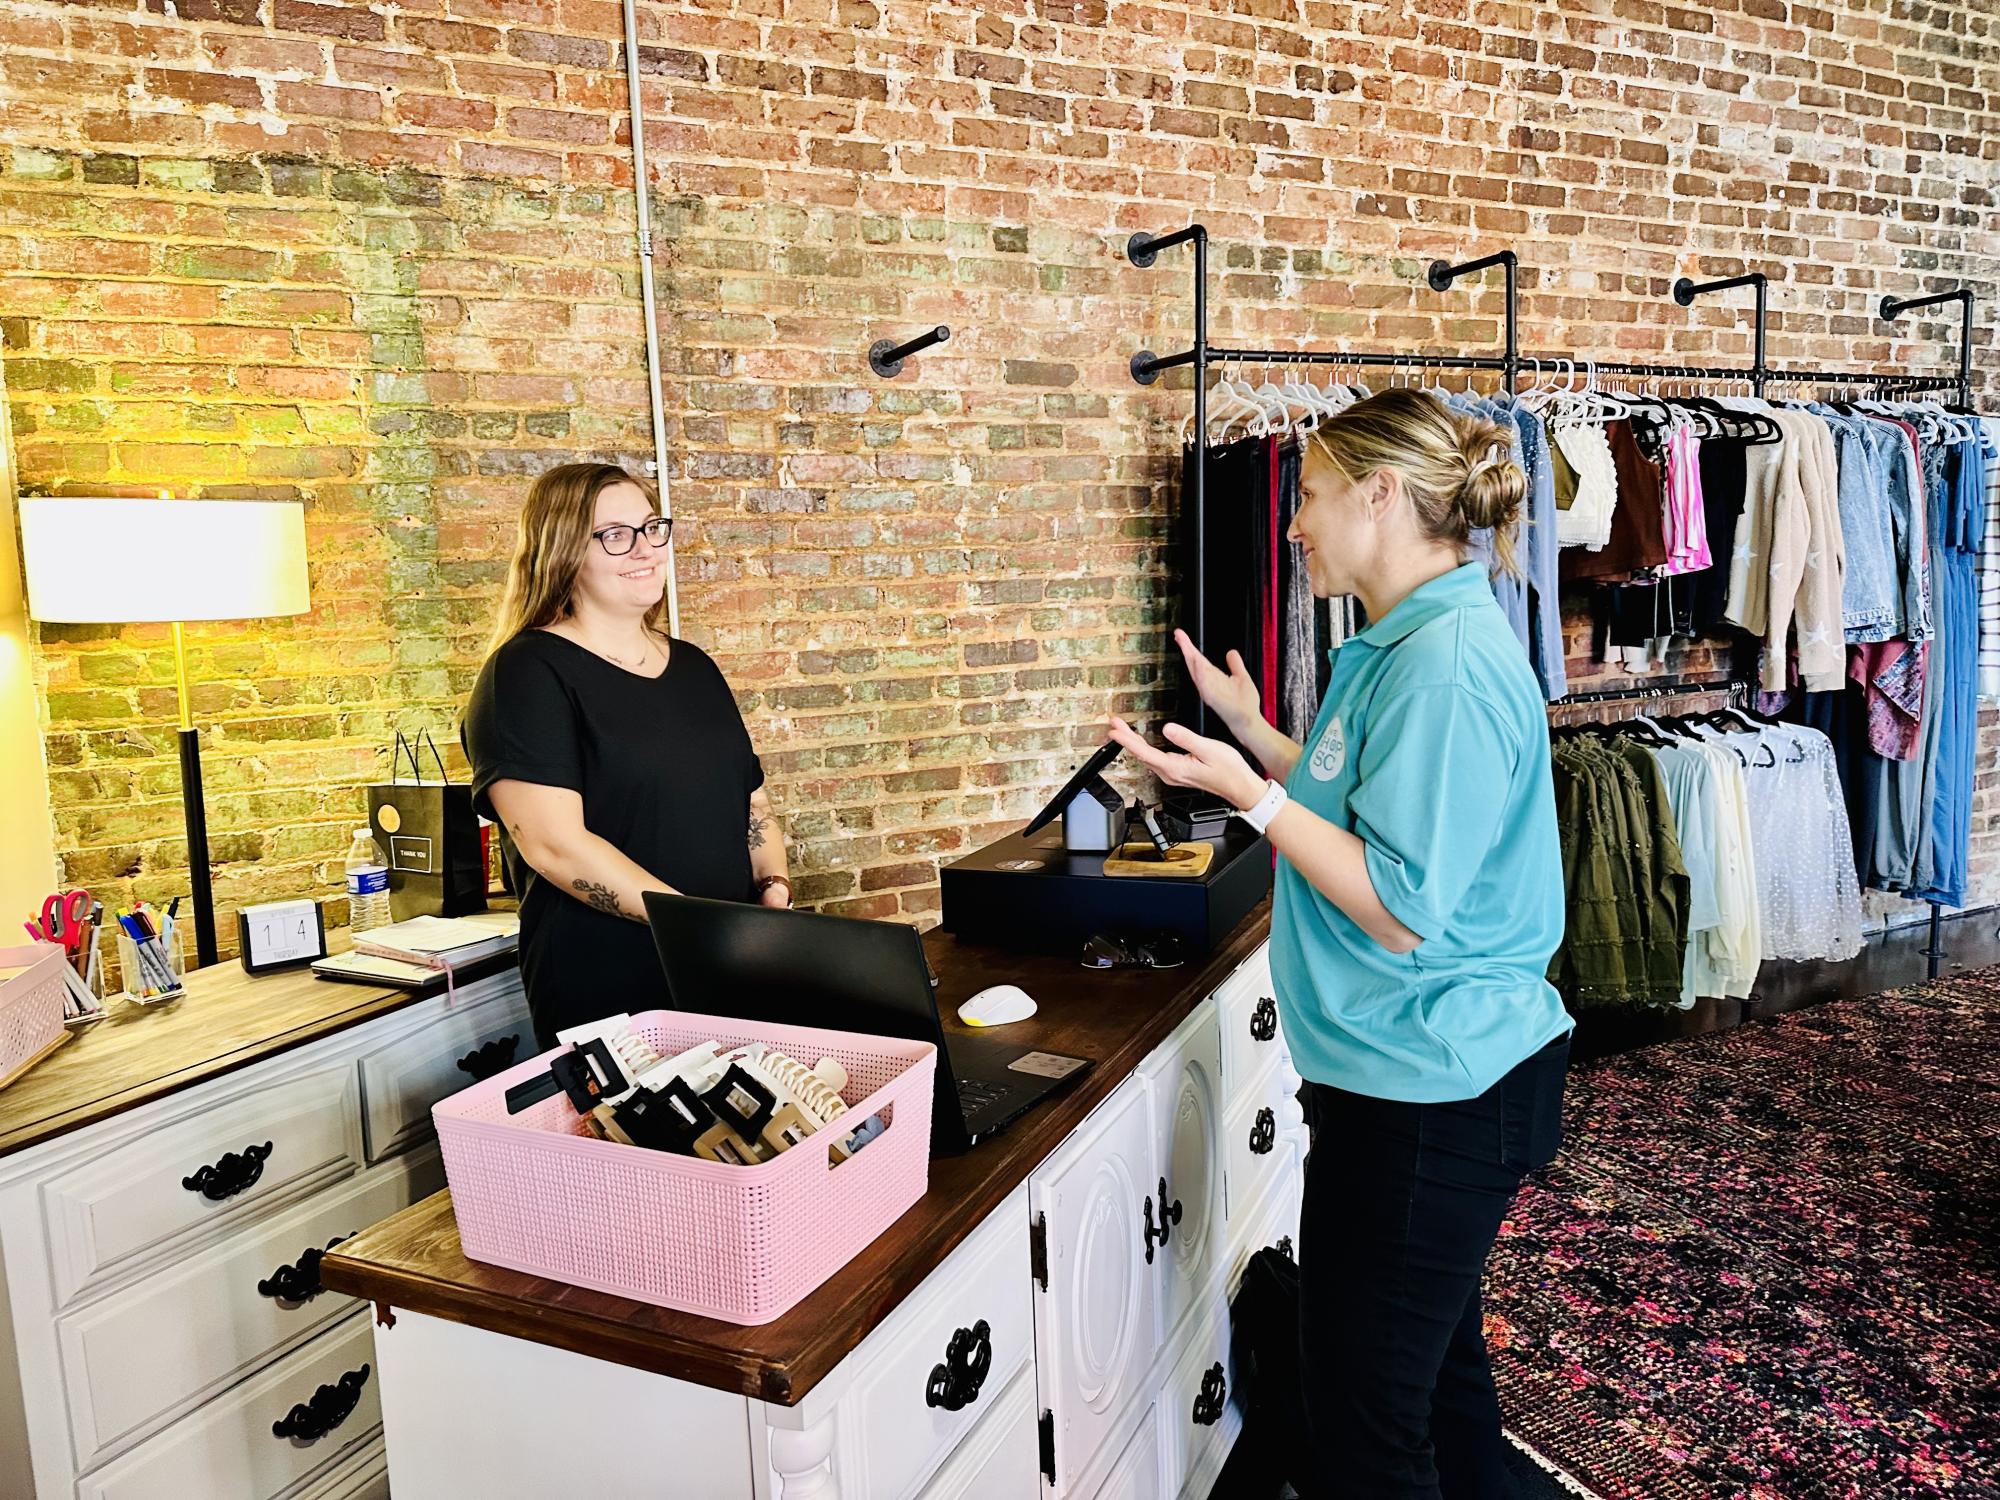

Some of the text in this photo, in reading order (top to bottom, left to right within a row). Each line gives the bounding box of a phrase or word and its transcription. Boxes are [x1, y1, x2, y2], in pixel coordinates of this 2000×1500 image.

[1313, 750, 1335, 771] SC
[400, 849, 416, 857] THANK
[263, 919, 306, 947] 1 4
